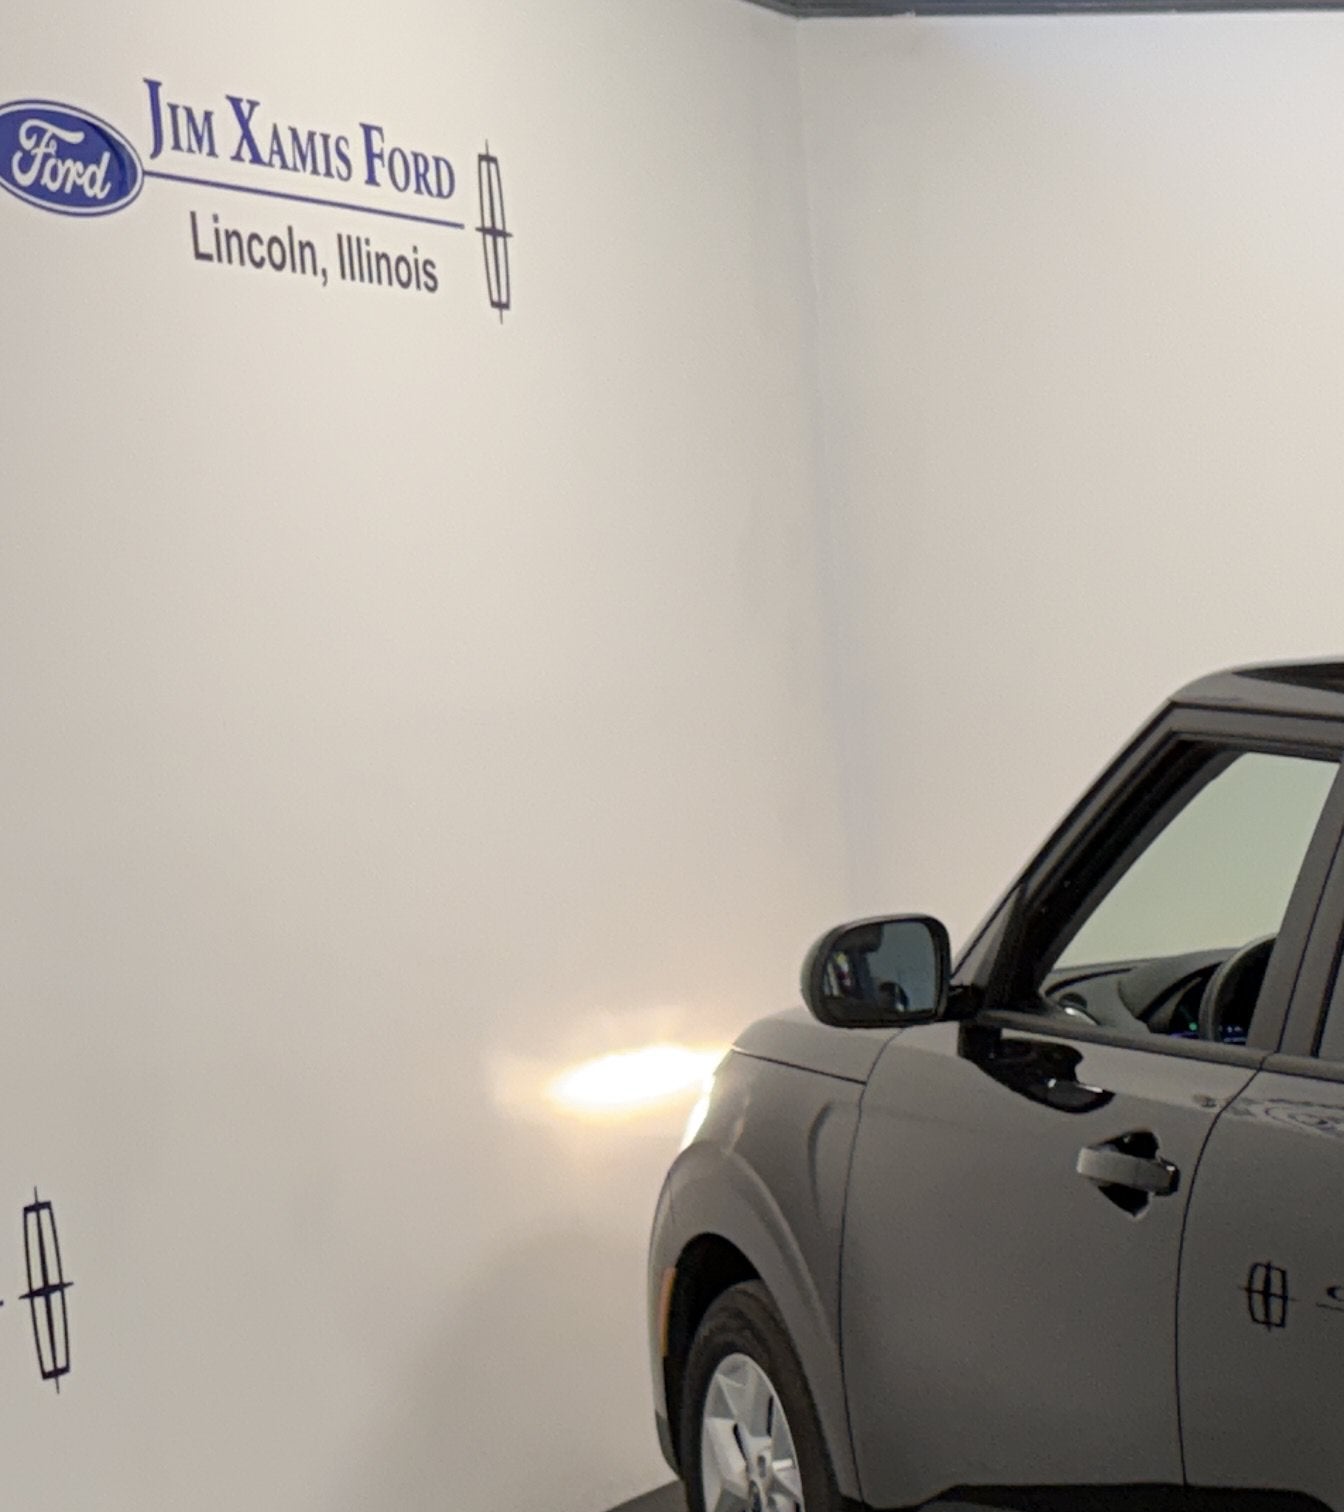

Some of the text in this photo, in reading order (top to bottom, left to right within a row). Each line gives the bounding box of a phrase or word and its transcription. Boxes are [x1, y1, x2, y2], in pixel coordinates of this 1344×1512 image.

[11, 119, 110, 199] Ford
[143, 78, 455, 199] JIM XAMIS FORD
[189, 210, 438, 292] Lincoln, Illinois
